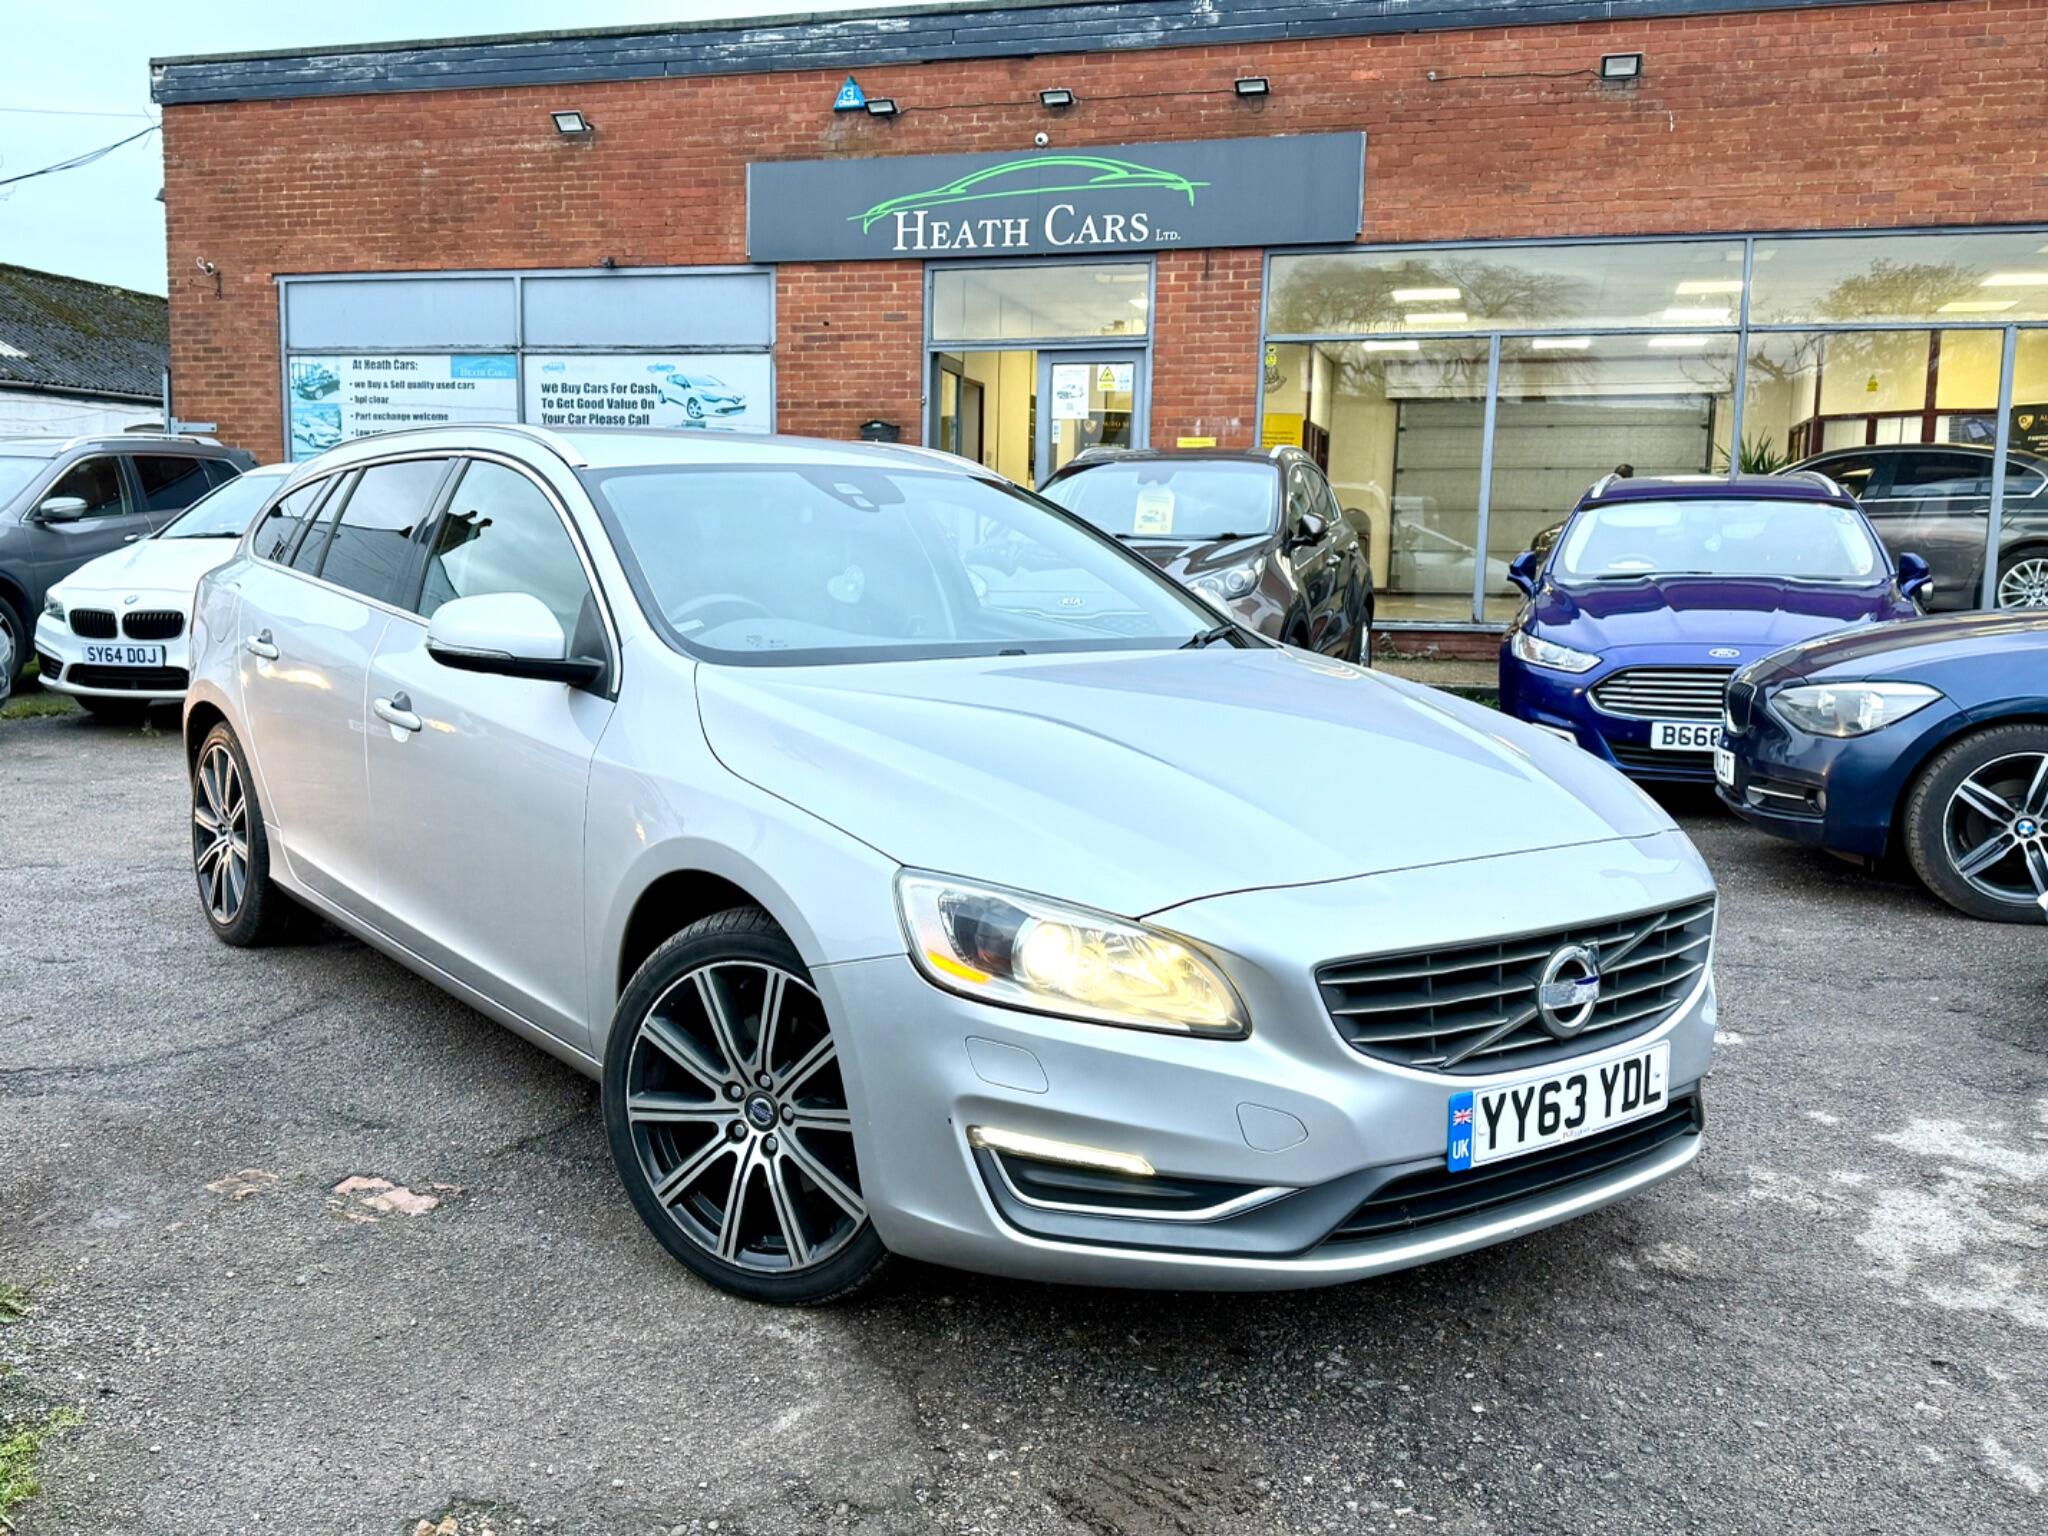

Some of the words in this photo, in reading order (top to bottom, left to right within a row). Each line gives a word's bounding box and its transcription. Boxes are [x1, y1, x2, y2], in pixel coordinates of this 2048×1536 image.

[892, 210, 1030, 251] HEATH
[1044, 204, 1150, 246] CARS
[1155, 229, 1182, 241] LTD.
[353, 359, 362, 370] At
[364, 359, 391, 370] Heath
[394, 359, 418, 370] Cars:
[367, 380, 381, 390] Buy
[383, 381, 389, 389] &
[391, 380, 405, 389] Sell
[407, 380, 435, 391] quality
[436, 380, 455, 390] used
[457, 382, 475, 390] cars
[561, 382, 582, 395] Buy
[584, 382, 609, 394] Cars
[611, 382, 628, 394] For
[631, 382, 658, 394] Cash
[369, 395, 389, 404] clear
[541, 397, 554, 409] To
[557, 397, 575, 409] Get
[577, 397, 605, 409] Good
[607, 397, 638, 409] Value
[641, 398, 655, 409] On
[356, 412, 371, 421] Part
[373, 412, 411, 422] exchange
[413, 411, 448, 421] welcome
[541, 412, 566, 425] Your
[568, 412, 587, 425] Car
[589, 412, 626, 425] Please
[628, 413, 650, 425] Call
[356, 429, 370, 437] Low
[87, 646, 123, 663] SY64
[126, 647, 157, 663] DOJ
[1481, 1074, 1588, 1150] YY63
[1600, 1053, 1662, 1119] YDL
[1452, 1140, 1470, 1161] UK
